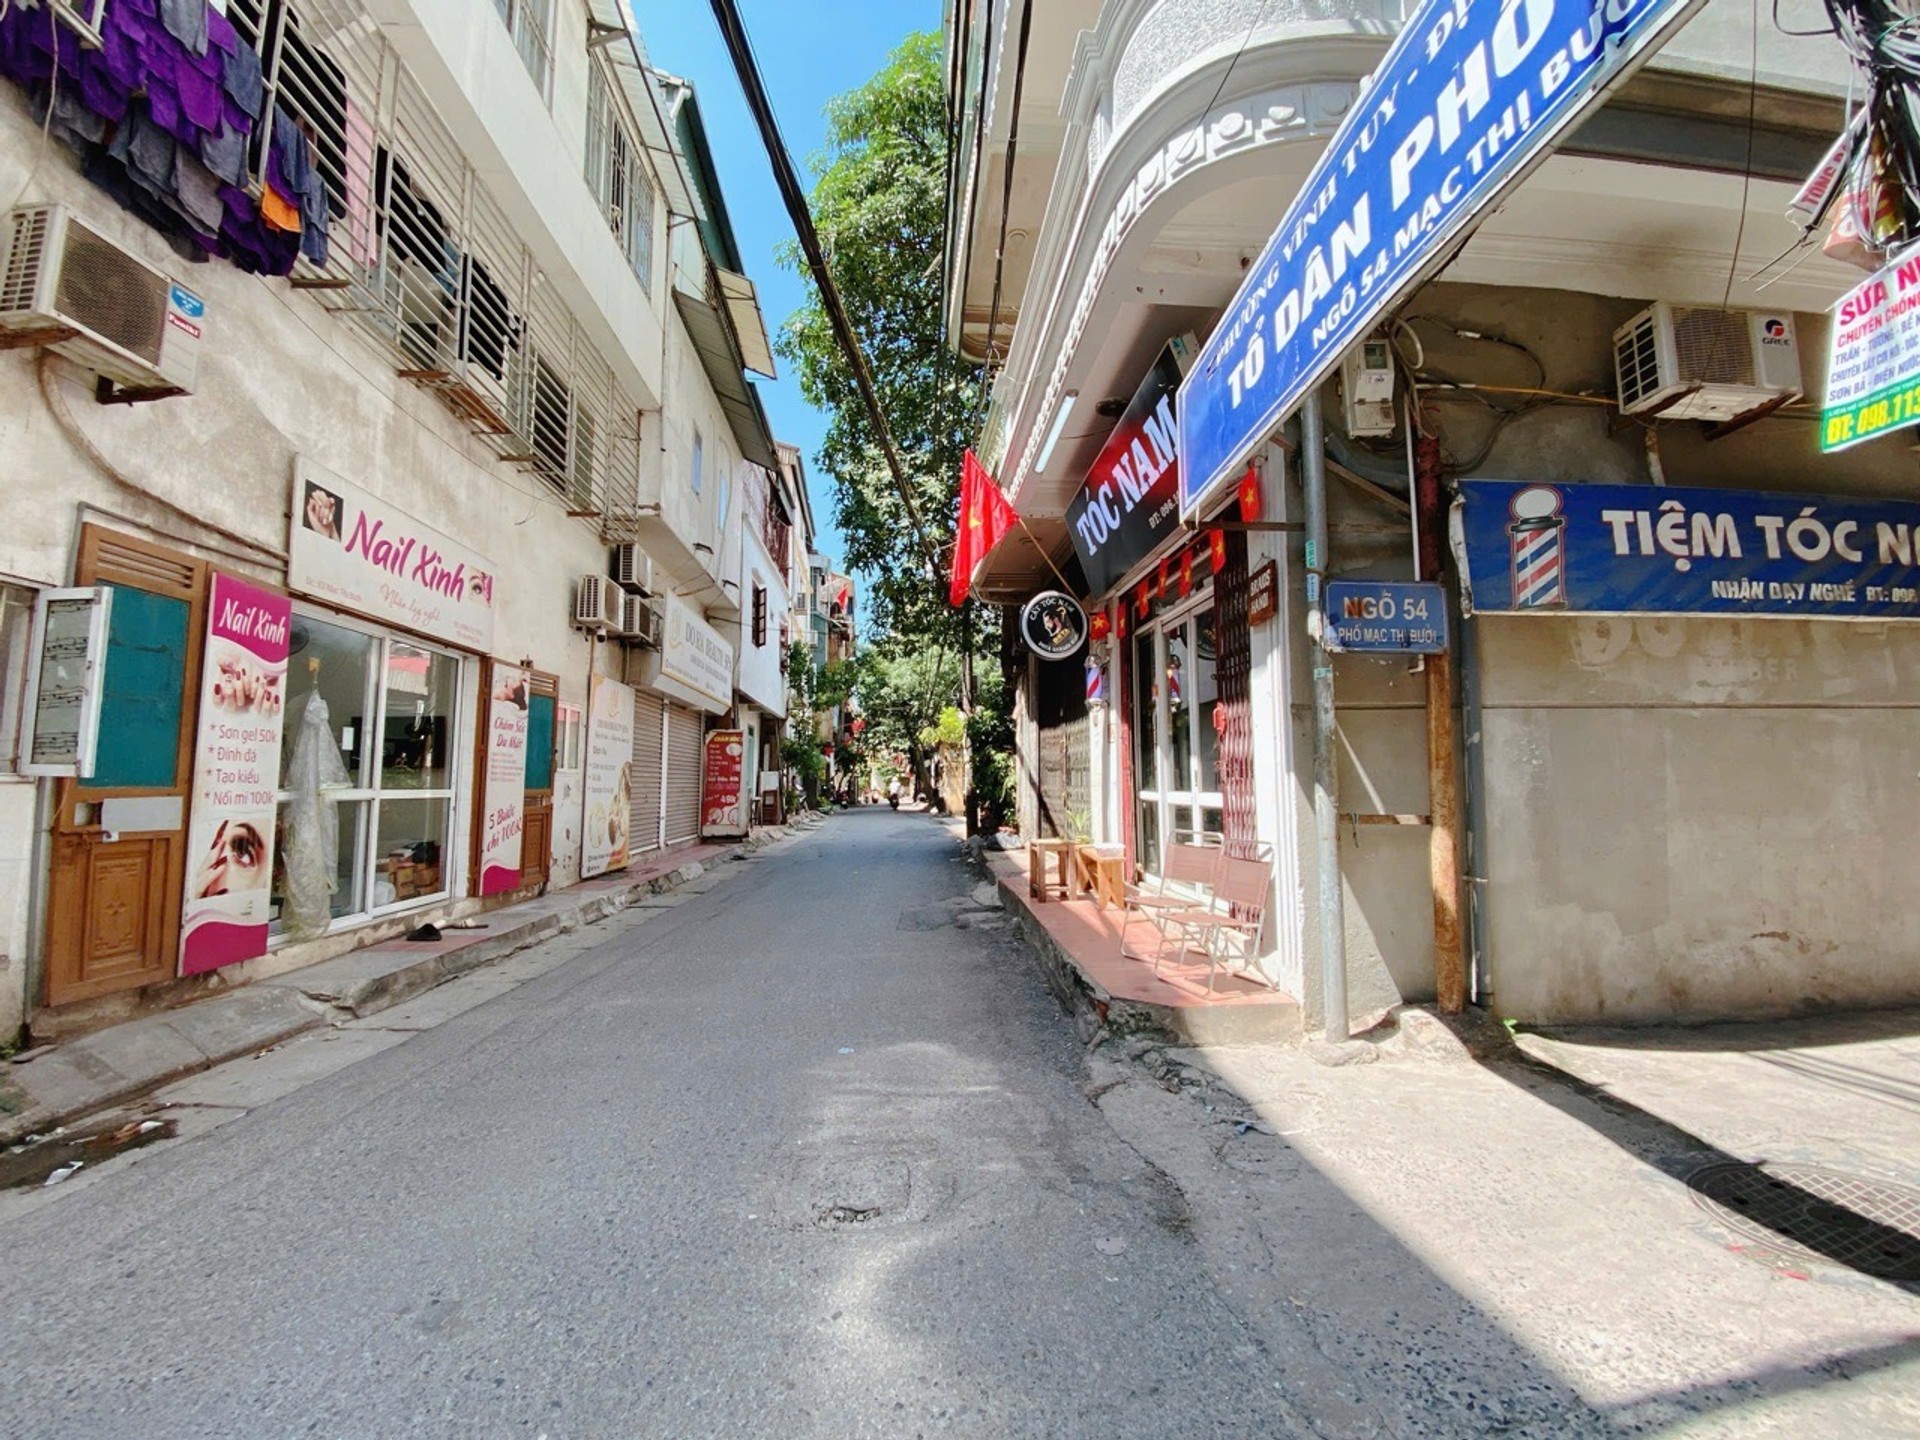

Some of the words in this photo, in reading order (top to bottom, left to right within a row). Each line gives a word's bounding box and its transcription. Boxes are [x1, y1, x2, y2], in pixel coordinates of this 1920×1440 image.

[1283, 173, 1337, 262] VĨNH
[1312, 281, 1356, 350] NGÕ
[1360, 248, 1389, 296] 54
[1394, 166, 1463, 259] MẠC
[1466, 88, 1530, 176] THỊ
[1228, 314, 1265, 409] TỔ
[1275, 191, 1371, 354] DÂN
[1840, 280, 1888, 326] SỬA
[1897, 256, 1920, 291] N
[1838, 313, 1882, 347] CHUYÊN
[1076, 486, 1121, 557] TÓC
[1111, 392, 1178, 513] NAM
[1601, 500, 1743, 572] TIỆM
[1755, 506, 1863, 563] TÓC
[345, 510, 416, 578] Nail
[412, 544, 464, 603] Xinh
[1343, 590, 1396, 619] NGÕ
[1403, 598, 1428, 620] 54
[1712, 577, 1764, 603] NHẬN
[1769, 581, 1805, 604] DẠY
[218, 598, 257, 637] Nail
[253, 609, 287, 646] Xinh
[1338, 623, 1361, 642] PHỐ
[1363, 628, 1387, 646] MẠC
[218, 724, 240, 740] Sơn
[241, 728, 258, 744] gel
[259, 729, 278, 744] 50k
[244, 748, 258, 763] đá
[215, 768, 236, 784] Tạo
[213, 790, 233, 805] Nối
[250, 790, 274, 806] 100k
[489, 813, 495, 830] 5
